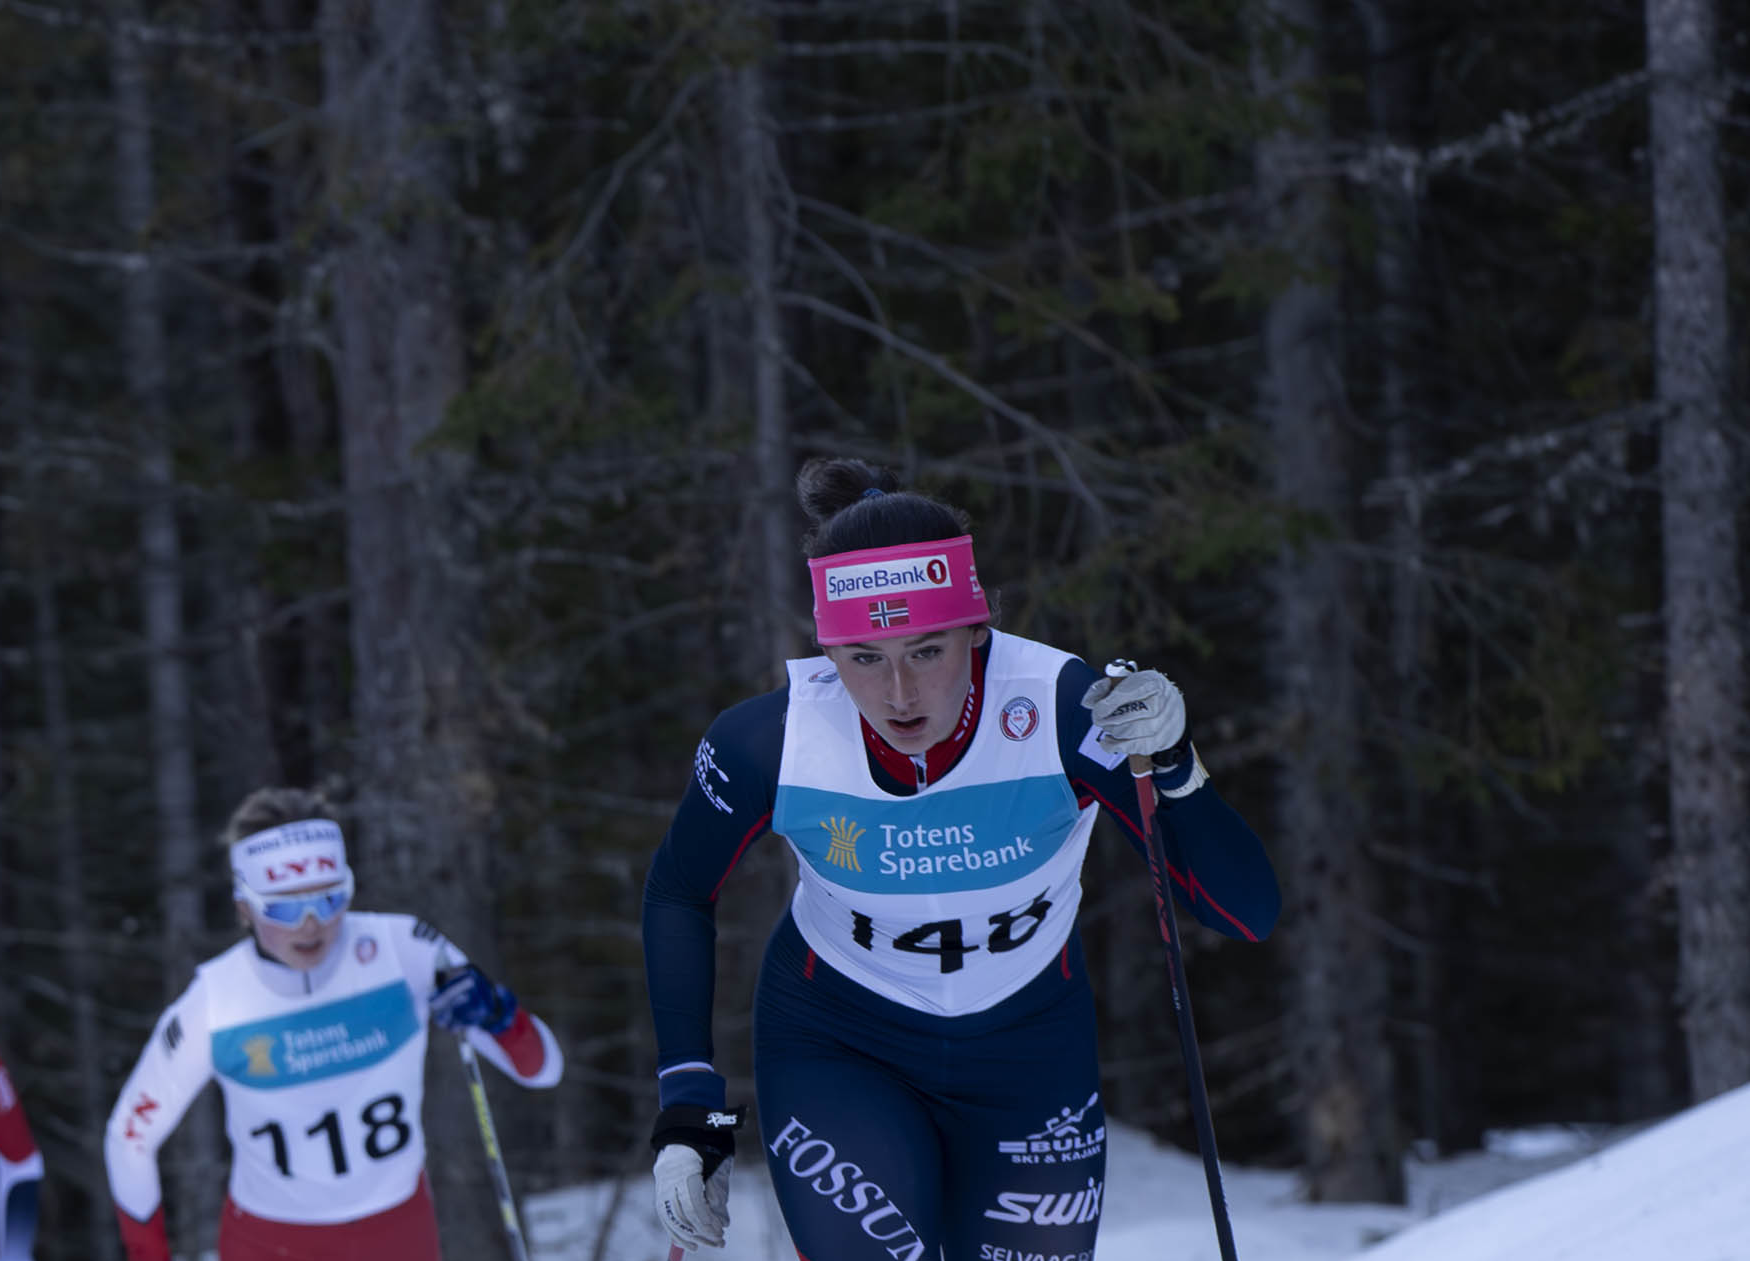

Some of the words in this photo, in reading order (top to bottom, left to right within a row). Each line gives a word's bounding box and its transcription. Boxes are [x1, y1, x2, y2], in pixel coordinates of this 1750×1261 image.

[828, 565, 926, 597] SpareBank
[880, 823, 975, 849] Totens
[879, 837, 1035, 880] Sparebank
[251, 1093, 412, 1178] 118
